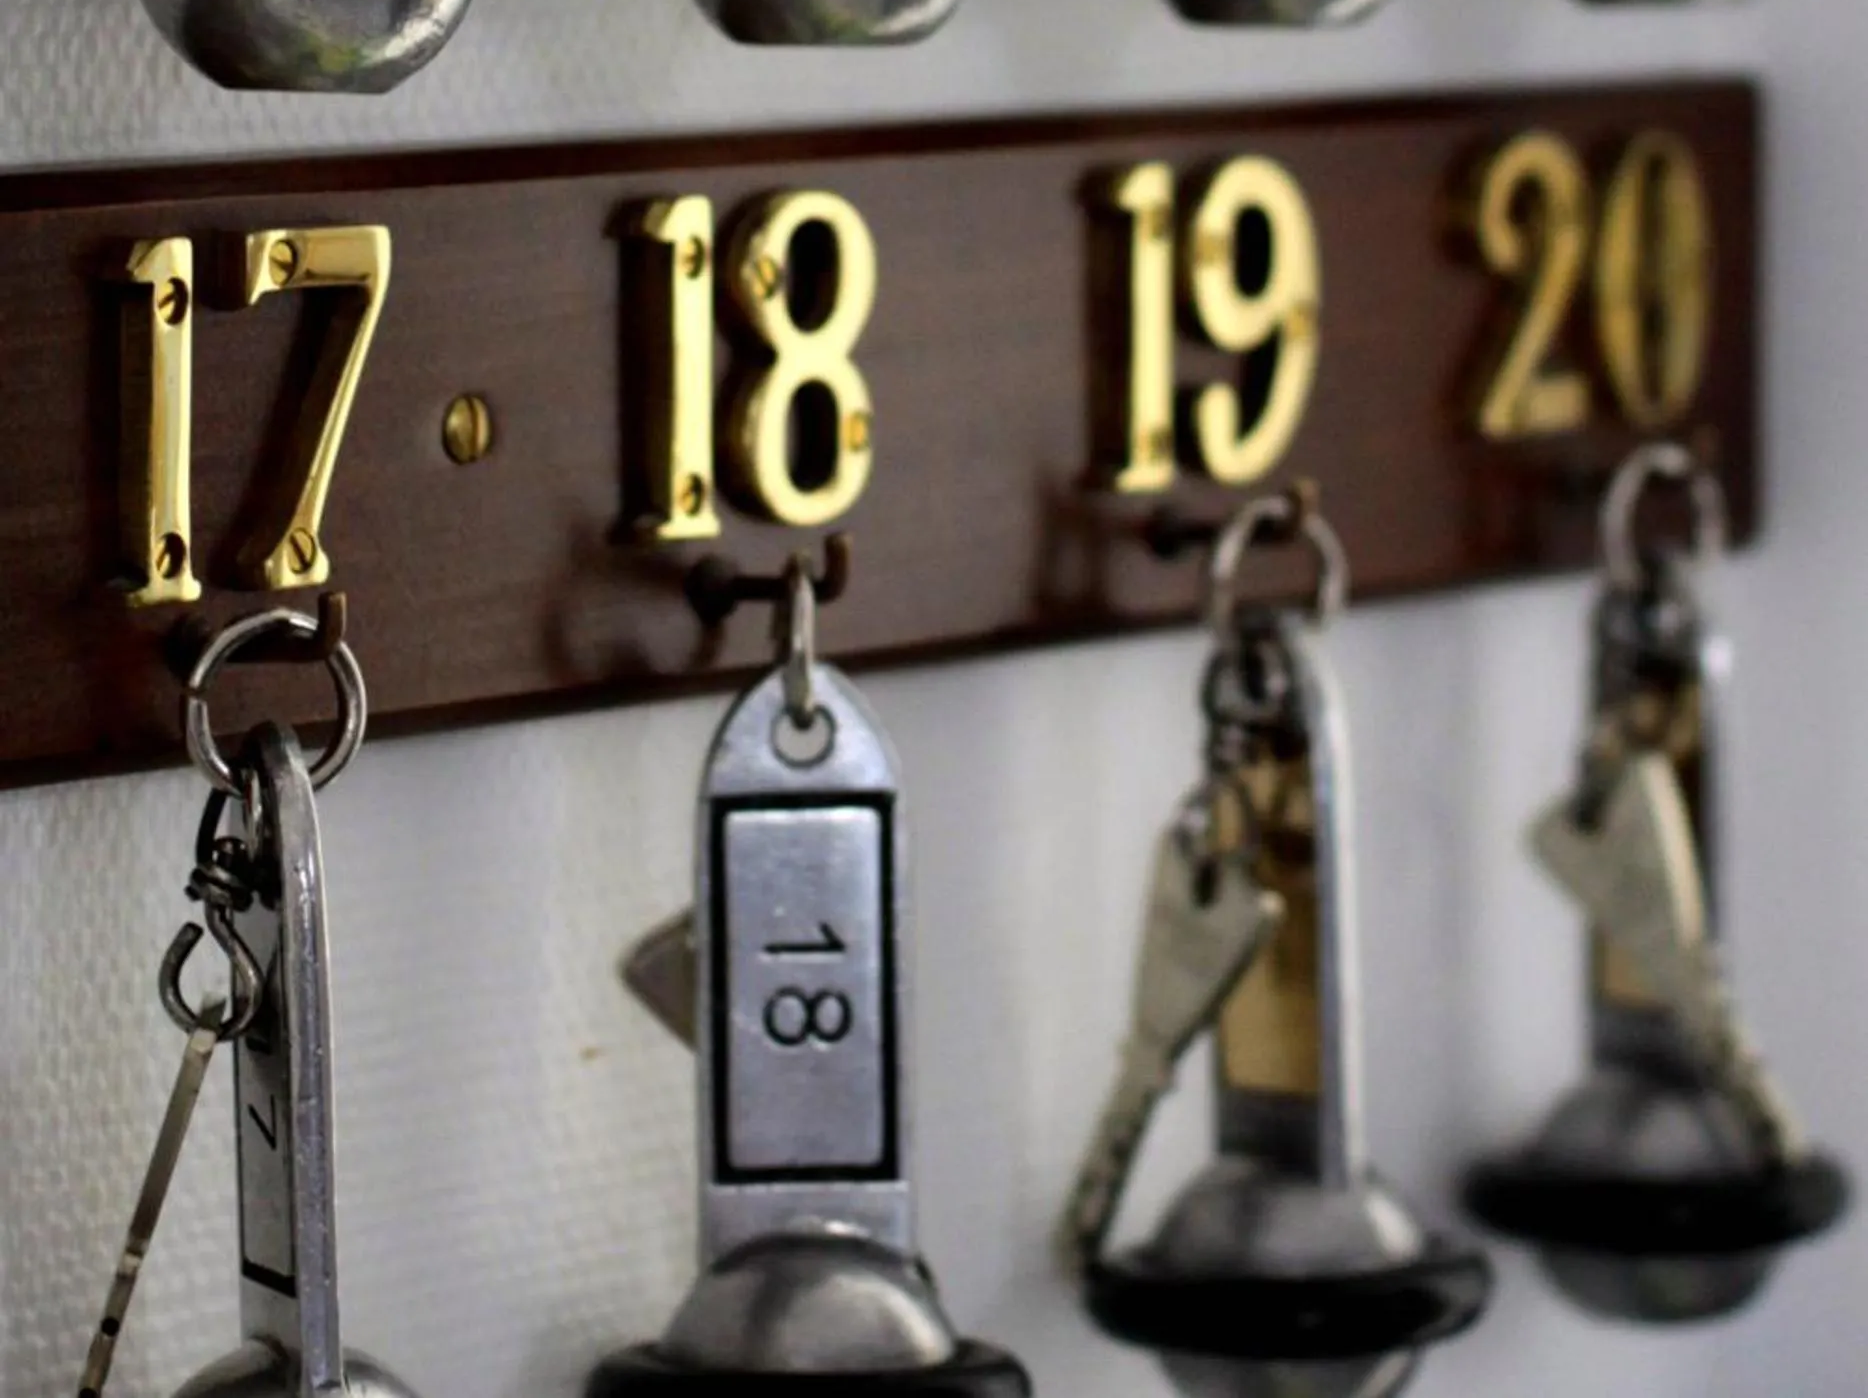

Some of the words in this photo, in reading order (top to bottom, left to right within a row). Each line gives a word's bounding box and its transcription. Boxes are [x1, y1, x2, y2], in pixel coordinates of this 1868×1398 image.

[124, 224, 392, 606] 17
[645, 189, 877, 541] 18
[1114, 152, 1321, 495] 19
[1477, 130, 1713, 439] 20
[761, 921, 853, 1047] 18
